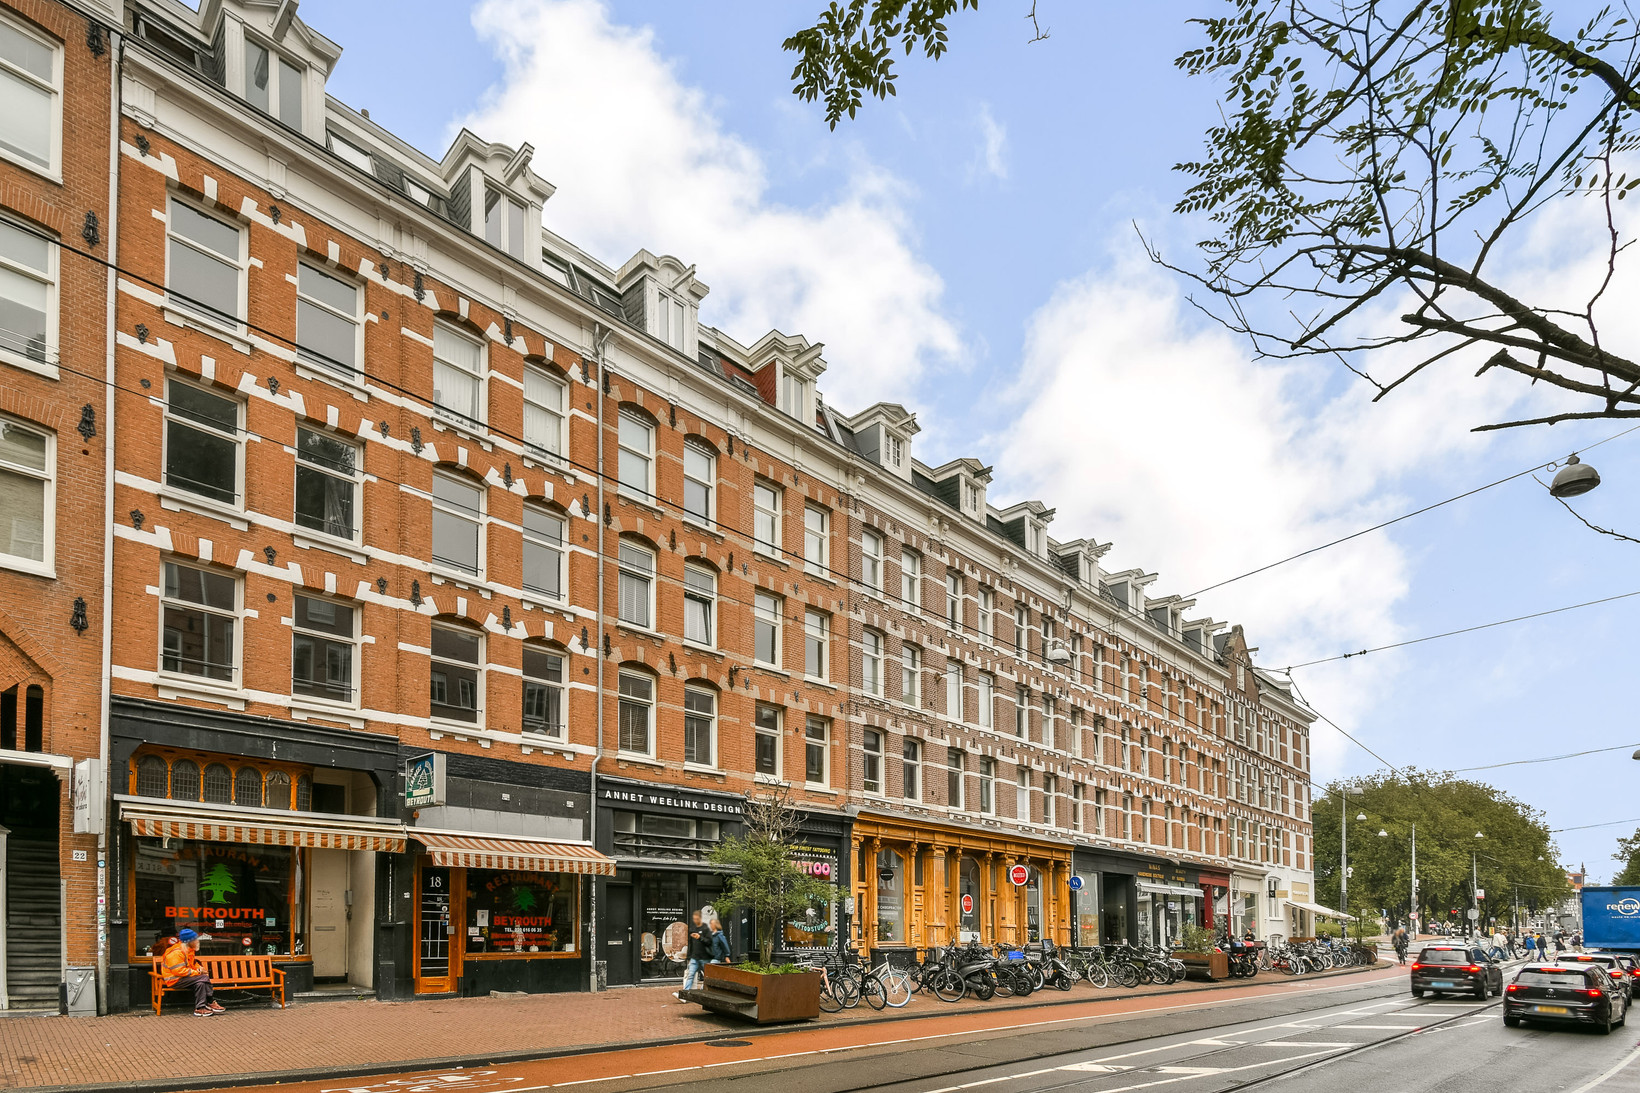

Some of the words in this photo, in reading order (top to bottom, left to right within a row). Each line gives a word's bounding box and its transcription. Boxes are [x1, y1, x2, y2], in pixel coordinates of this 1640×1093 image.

[407, 795, 434, 806] BEYROUTH
[605, 790, 643, 803] ANNET
[649, 796, 698, 809] WEELINK
[703, 802, 741, 814] DESIGN
[791, 861, 831, 875] TATTOO
[430, 876, 441, 888] 18
[165, 906, 265, 919] BEYROUTH
[494, 916, 552, 926] BEYROUTH
